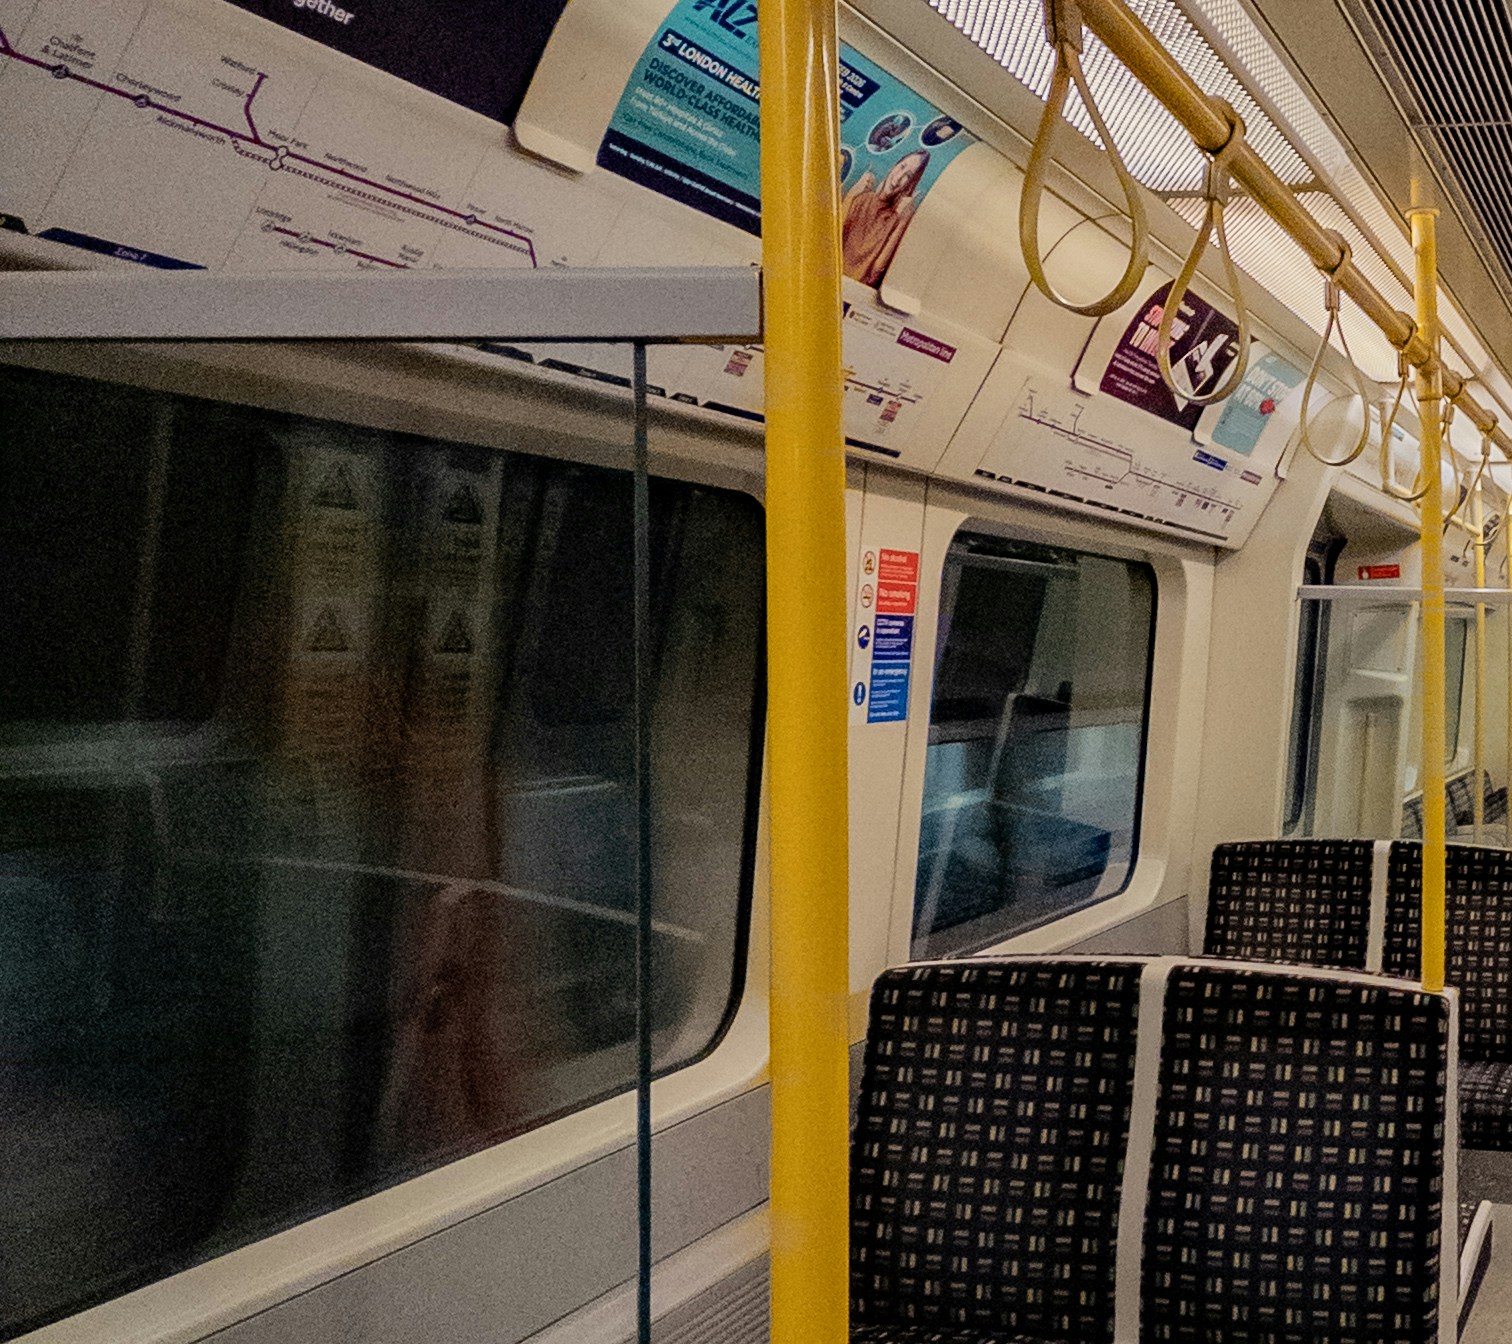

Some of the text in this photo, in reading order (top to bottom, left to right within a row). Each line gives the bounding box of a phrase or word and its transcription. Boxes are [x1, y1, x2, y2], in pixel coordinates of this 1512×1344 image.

[644, 68, 721, 121] WORLD-CLASS
[649, 57, 706, 94] DISCOVER
[678, 43, 728, 78] LONDON
[726, 70, 760, 100] HEALT
